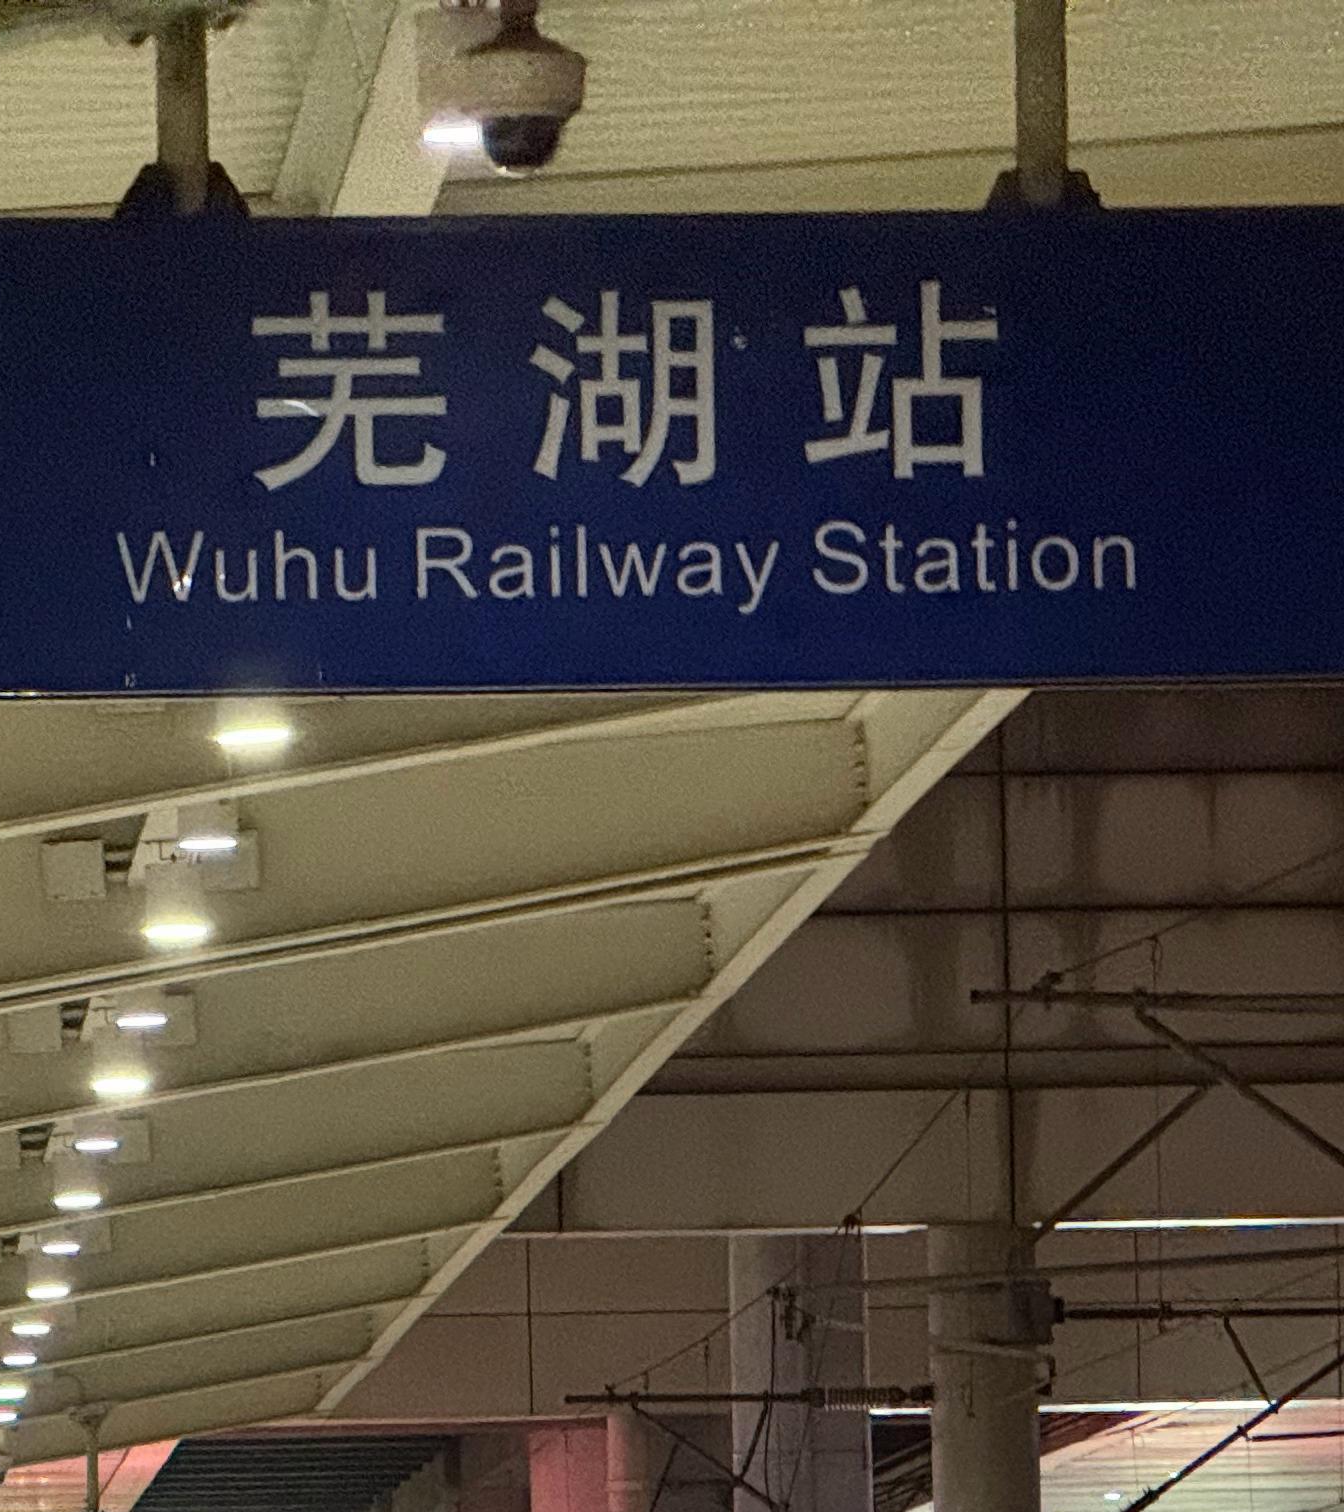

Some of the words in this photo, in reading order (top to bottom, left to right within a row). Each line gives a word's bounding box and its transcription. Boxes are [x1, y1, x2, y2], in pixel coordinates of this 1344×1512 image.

[251, 280, 999, 492] 芜湖站
[116, 529, 379, 602] Wuhu
[414, 524, 780, 614] Railway
[812, 520, 1138, 596] Station
